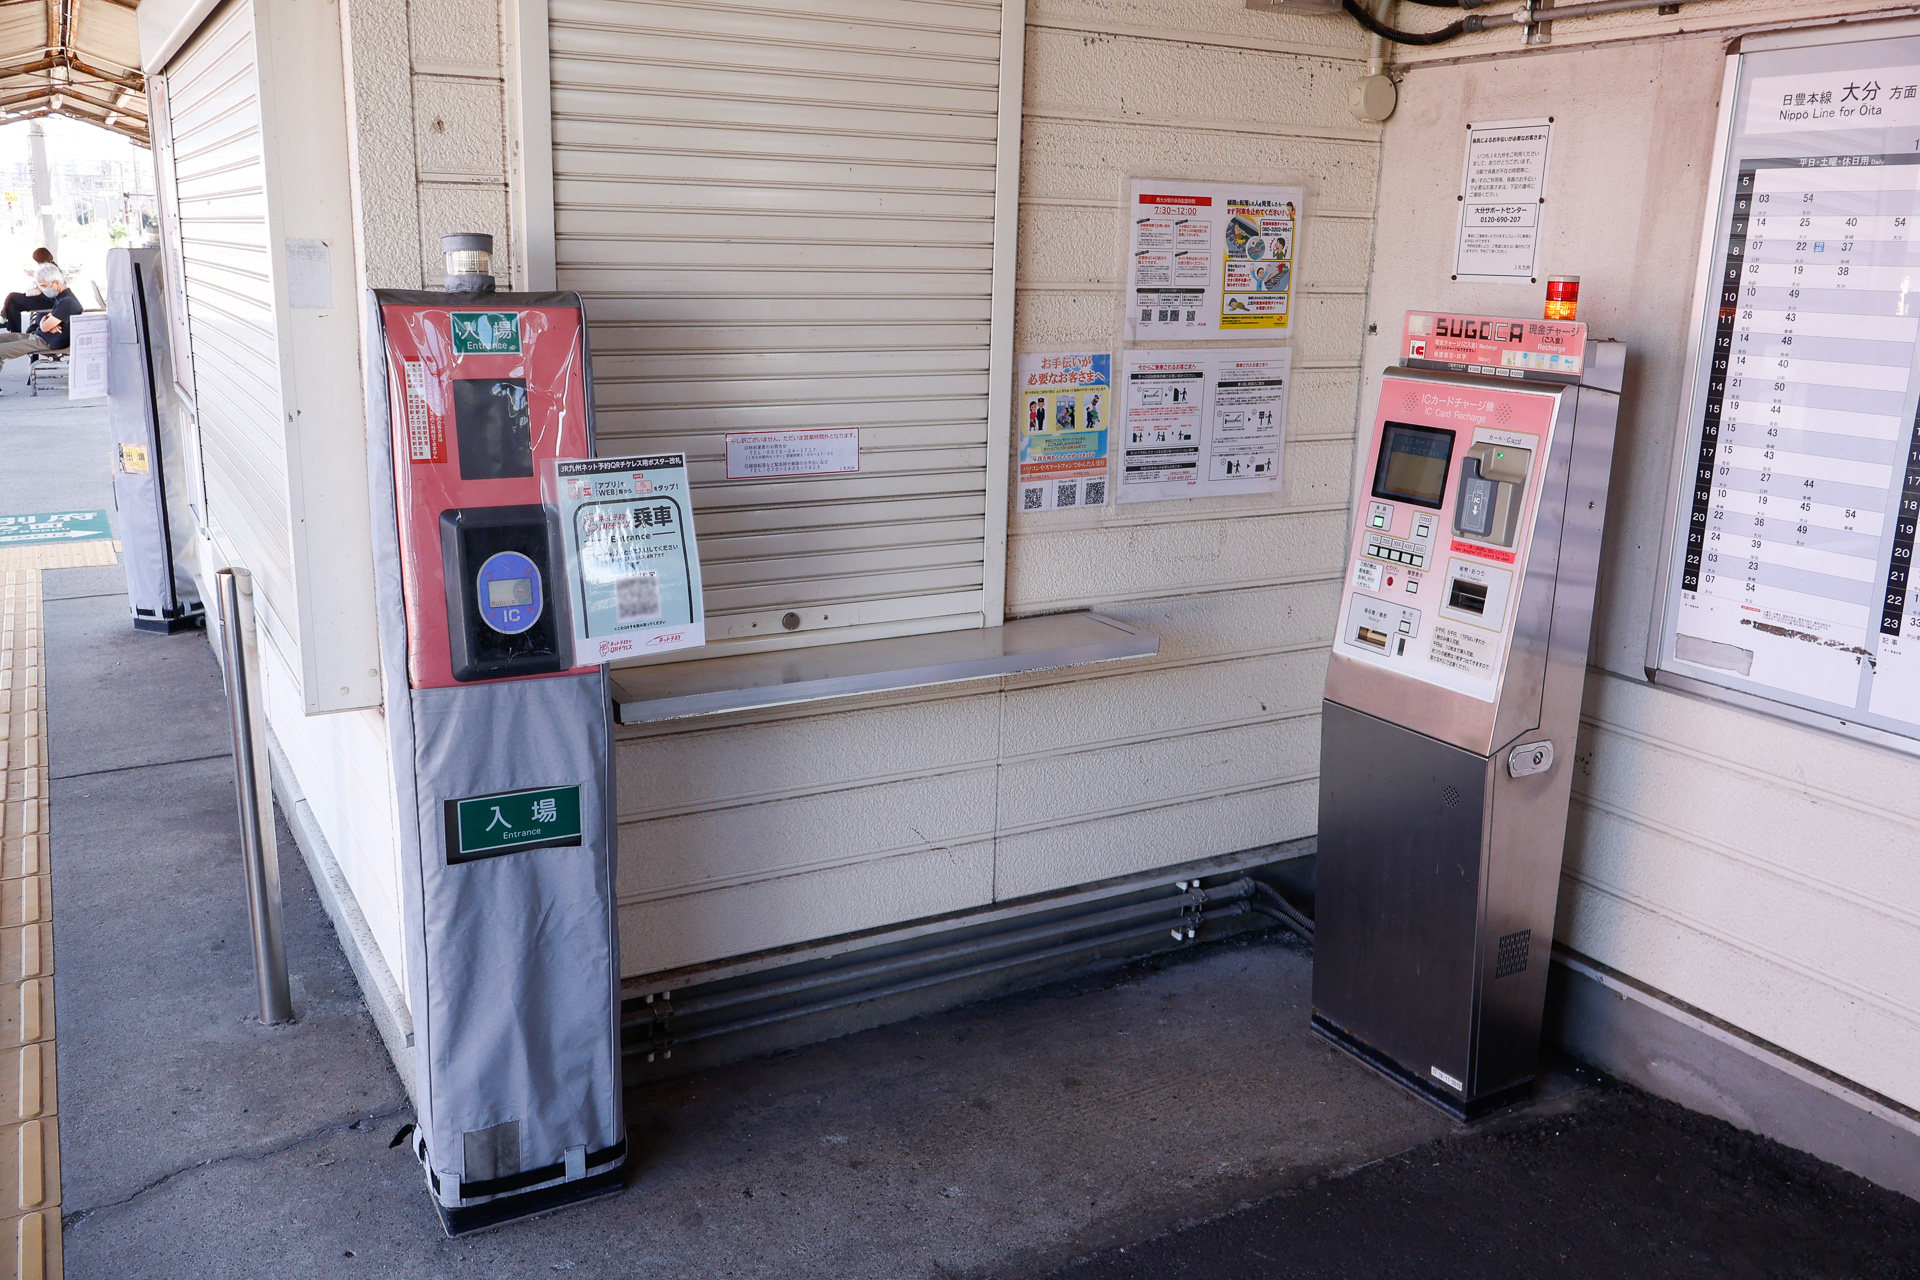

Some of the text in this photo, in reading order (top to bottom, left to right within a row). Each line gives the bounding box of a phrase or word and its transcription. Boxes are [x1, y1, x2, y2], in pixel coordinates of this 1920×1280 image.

[1782, 81, 1918, 106] 日豊本線 大分 方面
[1779, 103, 1882, 121] Nippō Line for Ōita
[1472, 135, 1546, 144] 係員によるお手伝いが必要なお客さまへ
[1871, 159, 1885, 167] Daily
[1742, 177, 1749, 186] 5
[1739, 193, 1814, 209] 6 03 54
[1474, 206, 1527, 214] 大分サポートセンター
[1737, 217, 1906, 232] 7 14 25 40 54
[1732, 246, 1739, 255] 8
[1752, 241, 1763, 250] 07
[1796, 241, 1807, 251] 22
[1841, 242, 1853, 252] 37
[1730, 264, 1849, 278] 9 02 19 38
[1724, 286, 1800, 301] 10 10 49
[1721, 310, 1796, 324] 11 26 43
[461, 320, 512, 339] 入場
[1435, 317, 1524, 343] SUGOCA
[1528, 324, 1580, 337] 現金チャージ
[467, 341, 507, 350] Entrance
[1541, 336, 1564, 345] (ご入金)
[1718, 334, 1792, 347] 12 14 48
[1537, 344, 1566, 353] Recharge
[1041, 355, 1092, 370] お手伝いが
[1715, 356, 1789, 369] 13 14 40
[1028, 370, 1105, 386] 必要なお客さまへ
[1712, 378, 1785, 391] 14 21 50
[1421, 393, 1495, 412] ICカードチャージ機
[1709, 401, 1781, 414] 15 19 44
[1425, 407, 1486, 424] IC Card Recharge
[1706, 423, 1778, 437] 16 15 43
[731, 432, 856, 444] 申し訳ございません。ただいま営業時間外となります。
[1703, 445, 1774, 460] 17 15 43
[560, 457, 681, 473] JR九州ネット予約QRチケレス用ポスター改札
[1023, 459, 1105, 472] パソコンやスマートフォンでかんたん受付
[1700, 467, 1814, 488] 18 07 27 44
[1908, 476, 1920, 485] 17
[1697, 489, 1856, 519] 19 10 19 45 54
[1904, 500, 1917, 510] 18
[634, 505, 673, 529] 乗車
[1693, 510, 1807, 534] 20 22 36 49
[1900, 524, 1913, 534] 19
[1690, 532, 1761, 549] 21 24 39
[1894, 548, 1910, 558] 20
[1687, 553, 1758, 571] 22 03 23
[1459, 566, 1486, 576] 紙幣・おつり
[1891, 571, 1904, 581] 21
[1684, 574, 1755, 592] 23 07 54
[1887, 595, 1902, 605] 22
[503, 609, 520, 623] IC
[1883, 618, 1898, 628] 23
[485, 798, 557, 832] 入場
[503, 828, 542, 840] Entrance
